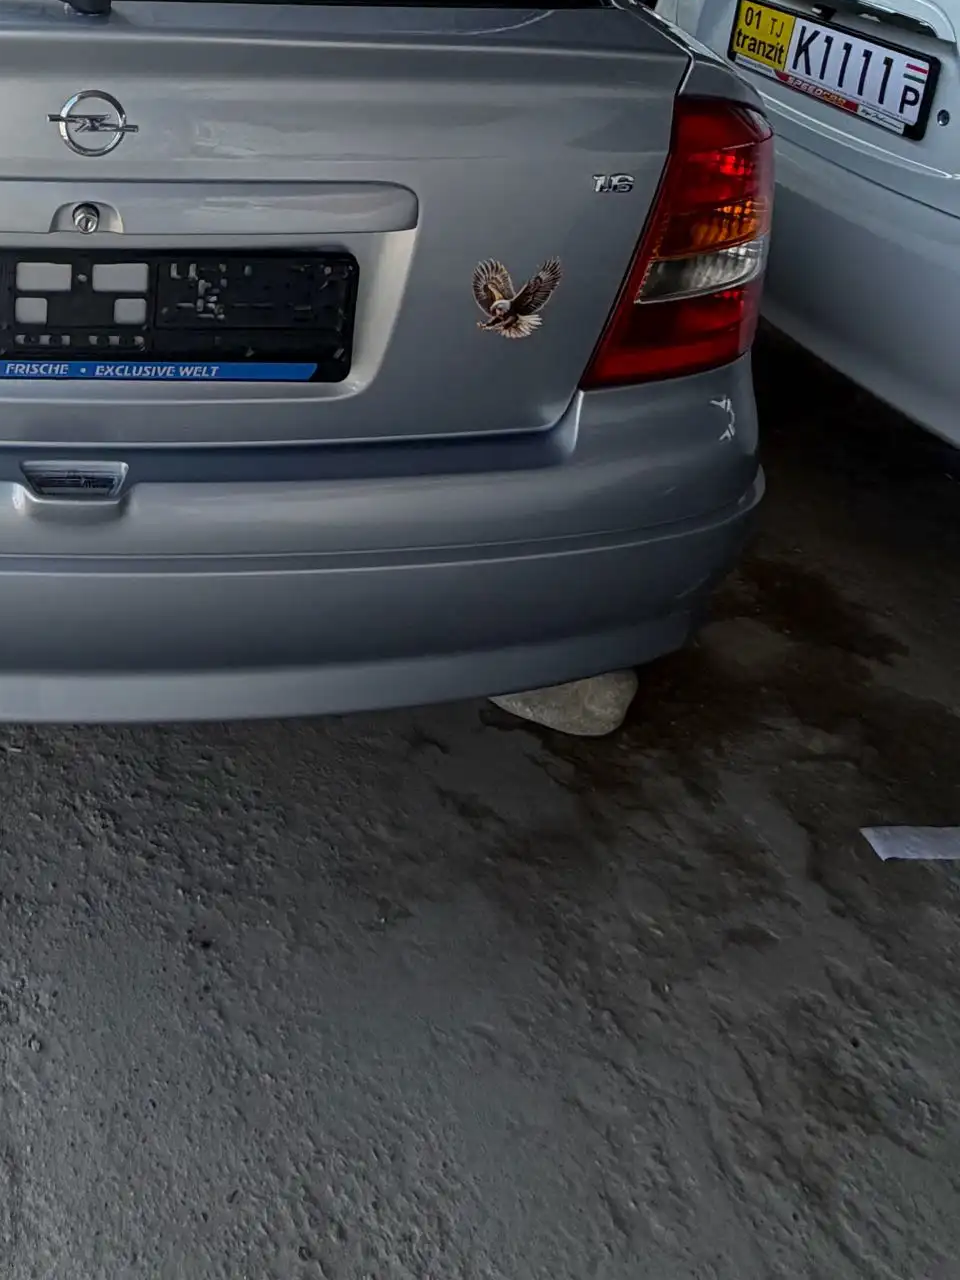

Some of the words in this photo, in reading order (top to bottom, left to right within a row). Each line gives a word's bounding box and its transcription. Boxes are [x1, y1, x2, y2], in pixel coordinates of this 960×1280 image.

[744, 6, 762, 28] 01
[768, 17, 785, 38] TJ
[734, 28, 785, 65] tranzit
[792, 25, 894, 105] K1111
[898, 85, 920, 114] P
[592, 173, 635, 193] 1.6
[5, 363, 69, 376] FRISCHE
[95, 364, 176, 378] EXCLUSIVE
[179, 365, 220, 378] WELT
